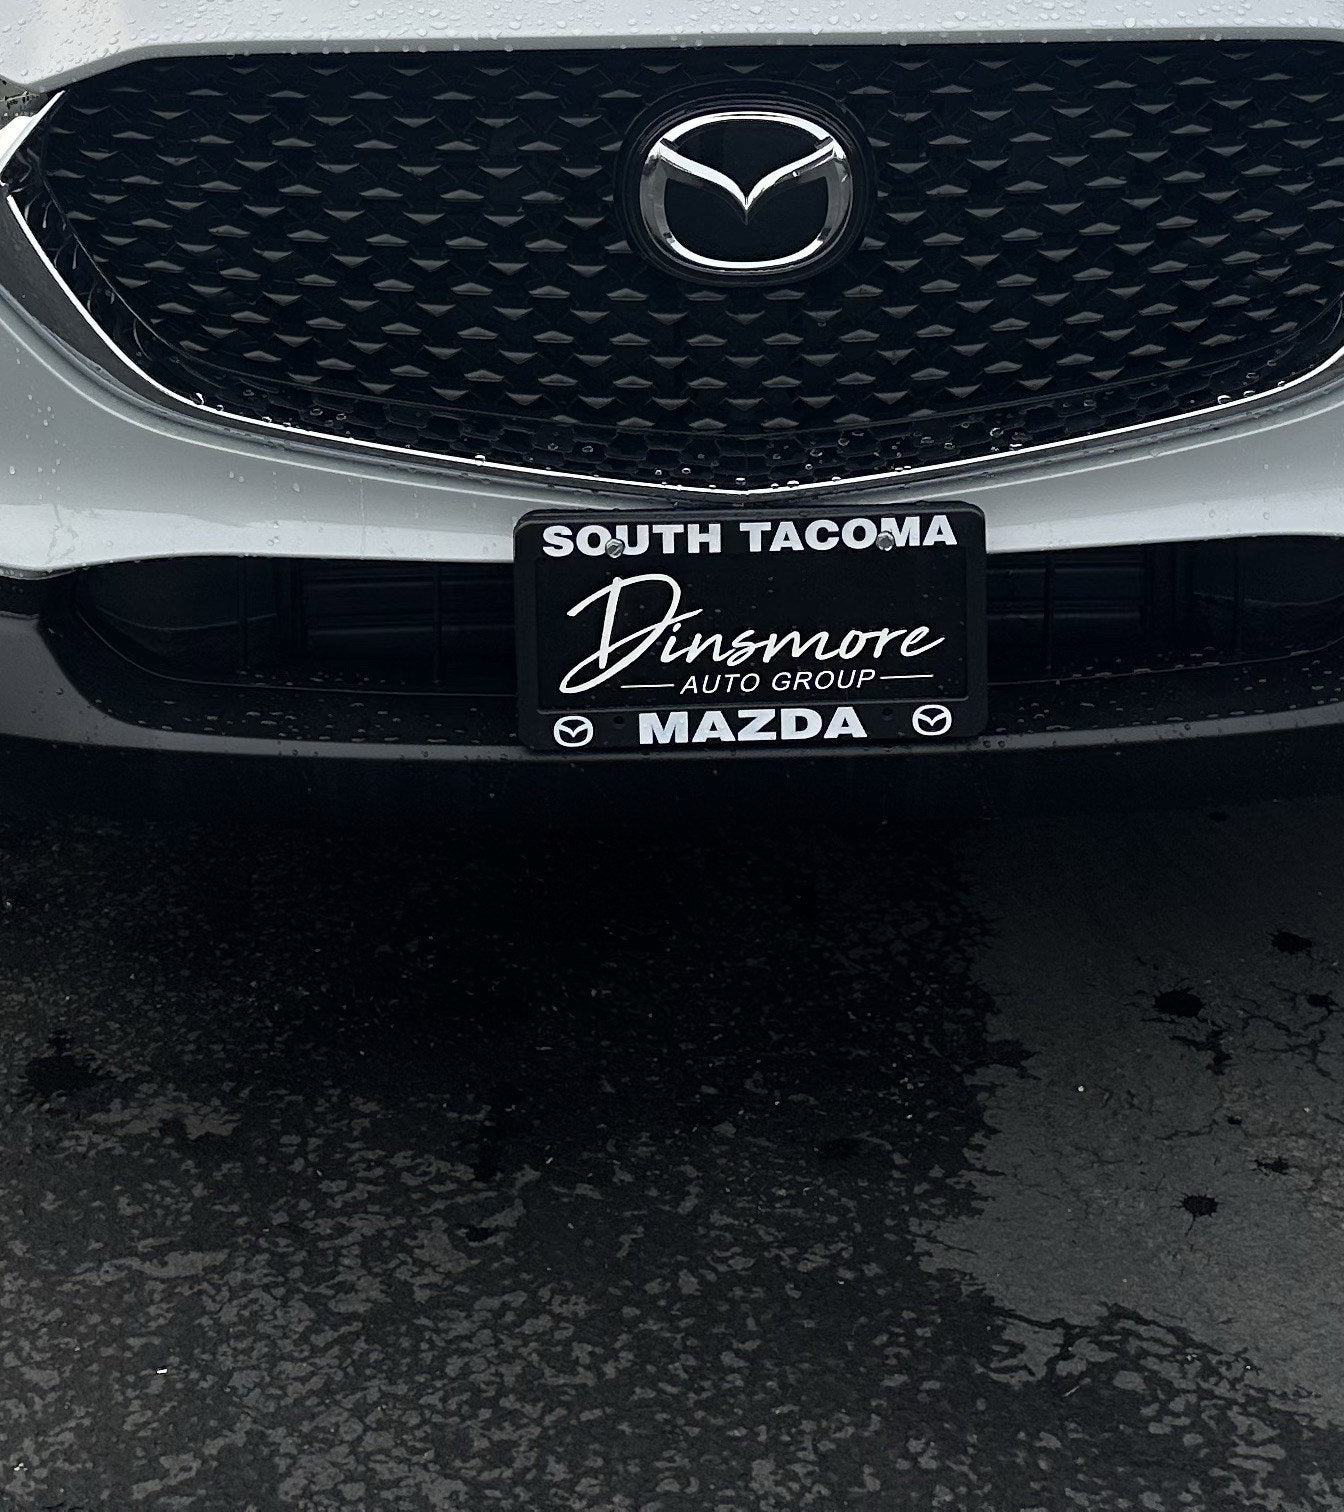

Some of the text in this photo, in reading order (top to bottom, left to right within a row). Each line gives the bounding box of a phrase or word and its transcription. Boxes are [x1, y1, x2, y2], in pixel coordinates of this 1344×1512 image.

[542, 514, 958, 557] SOUTH TACOMA
[558, 573, 945, 694] Dinsmore
[680, 669, 876, 694] AUTO GROUP
[638, 706, 868, 744] MAZDA
